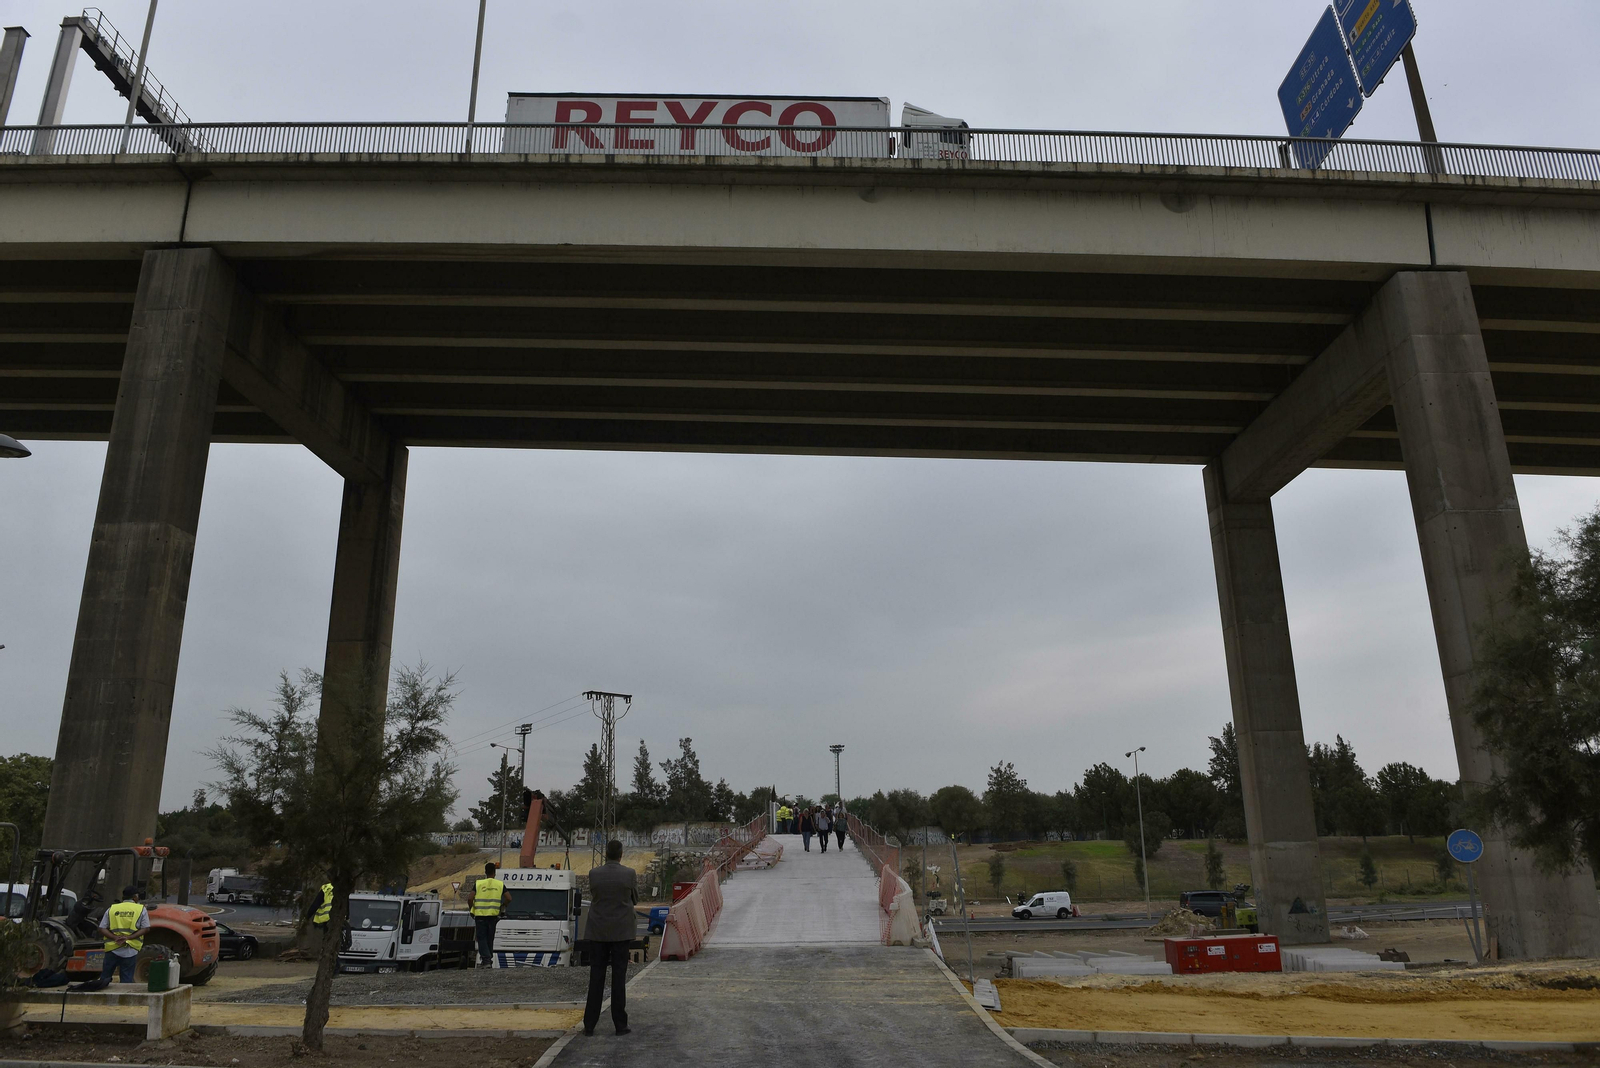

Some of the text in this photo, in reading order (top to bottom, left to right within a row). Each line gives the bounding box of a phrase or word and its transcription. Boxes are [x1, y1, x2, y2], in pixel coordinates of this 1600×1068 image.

[1357, 25, 1386, 66] Dos Hermanas
[1298, 56, 1329, 103] A-376 Utrera
[1300, 55, 1315, 78] SE-30
[1301, 69, 1335, 119] A-92 Granada
[551, 100, 838, 154] REYCO
[1311, 111, 1320, 126] A-4
[938, 149, 968, 160] REYCO
[502, 873, 553, 882] ROLDAN
